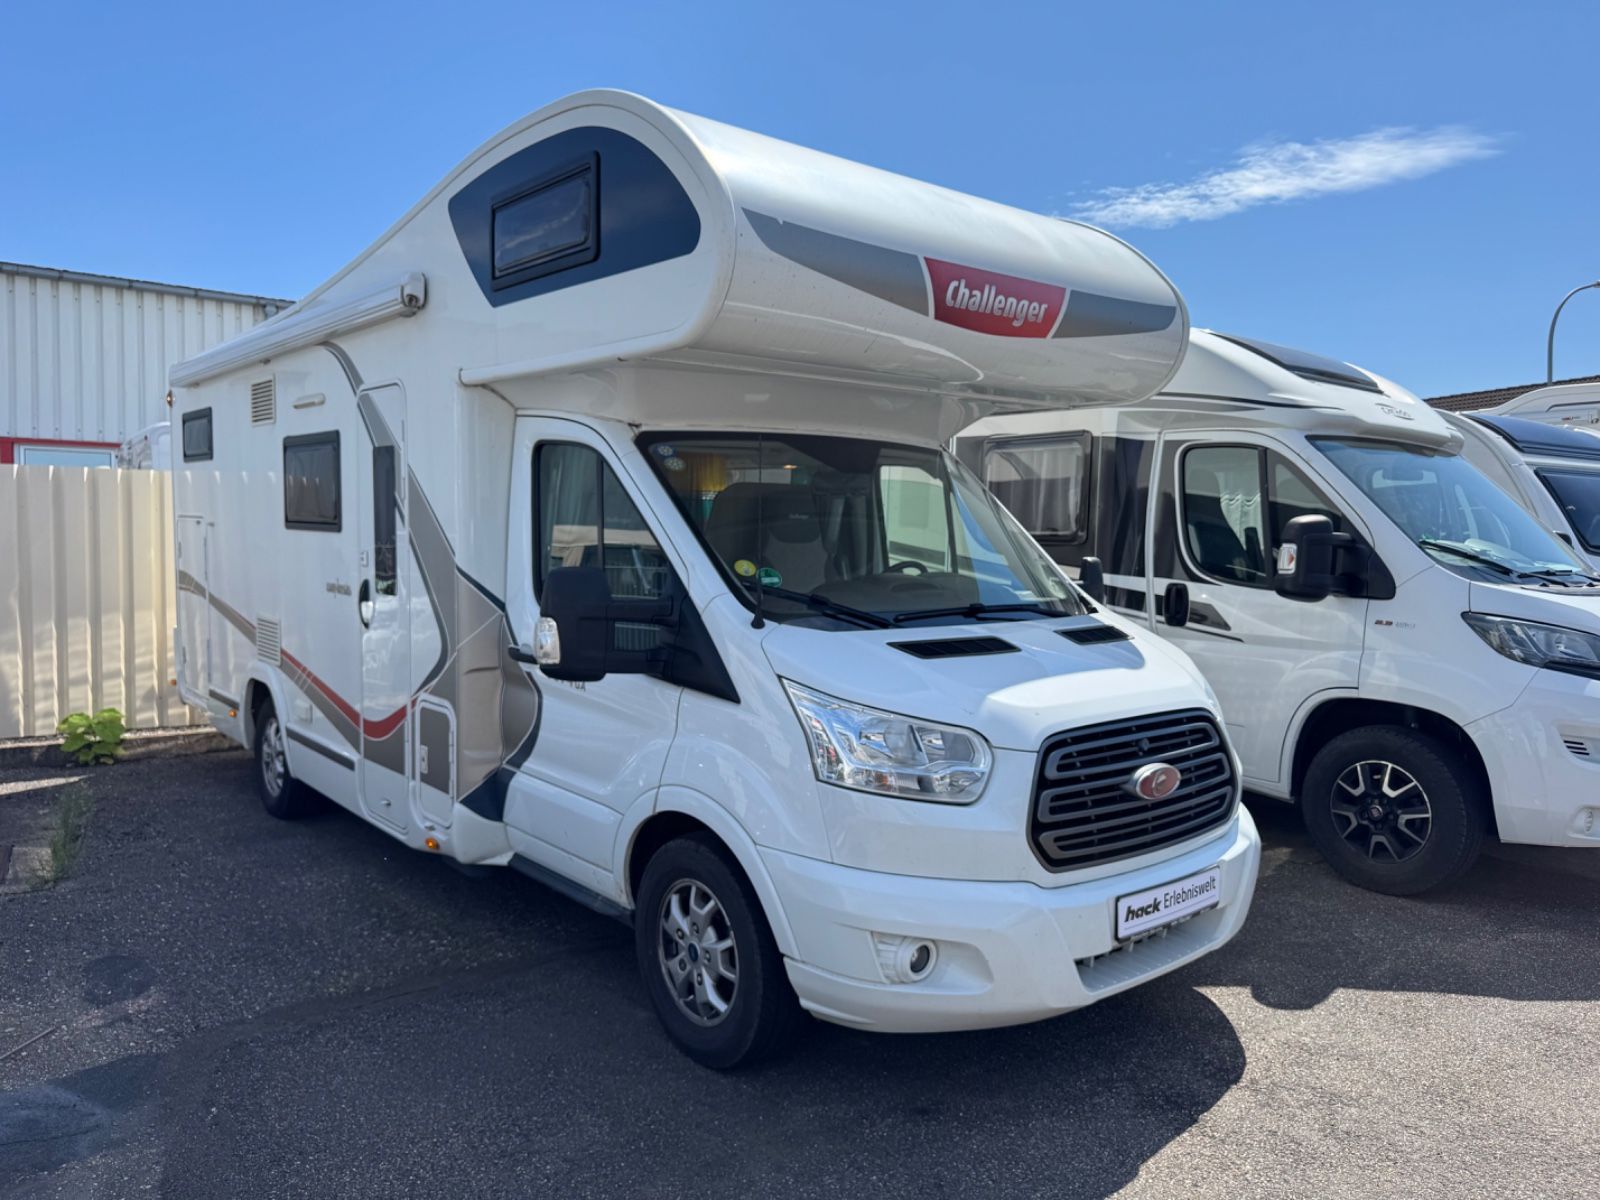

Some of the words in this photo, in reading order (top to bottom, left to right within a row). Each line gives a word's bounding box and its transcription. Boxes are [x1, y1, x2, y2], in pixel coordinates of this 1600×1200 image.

[945, 278, 1048, 327] Challenger
[1124, 897, 1161, 922] hack
[1163, 876, 1216, 909] Erlebniswelt
